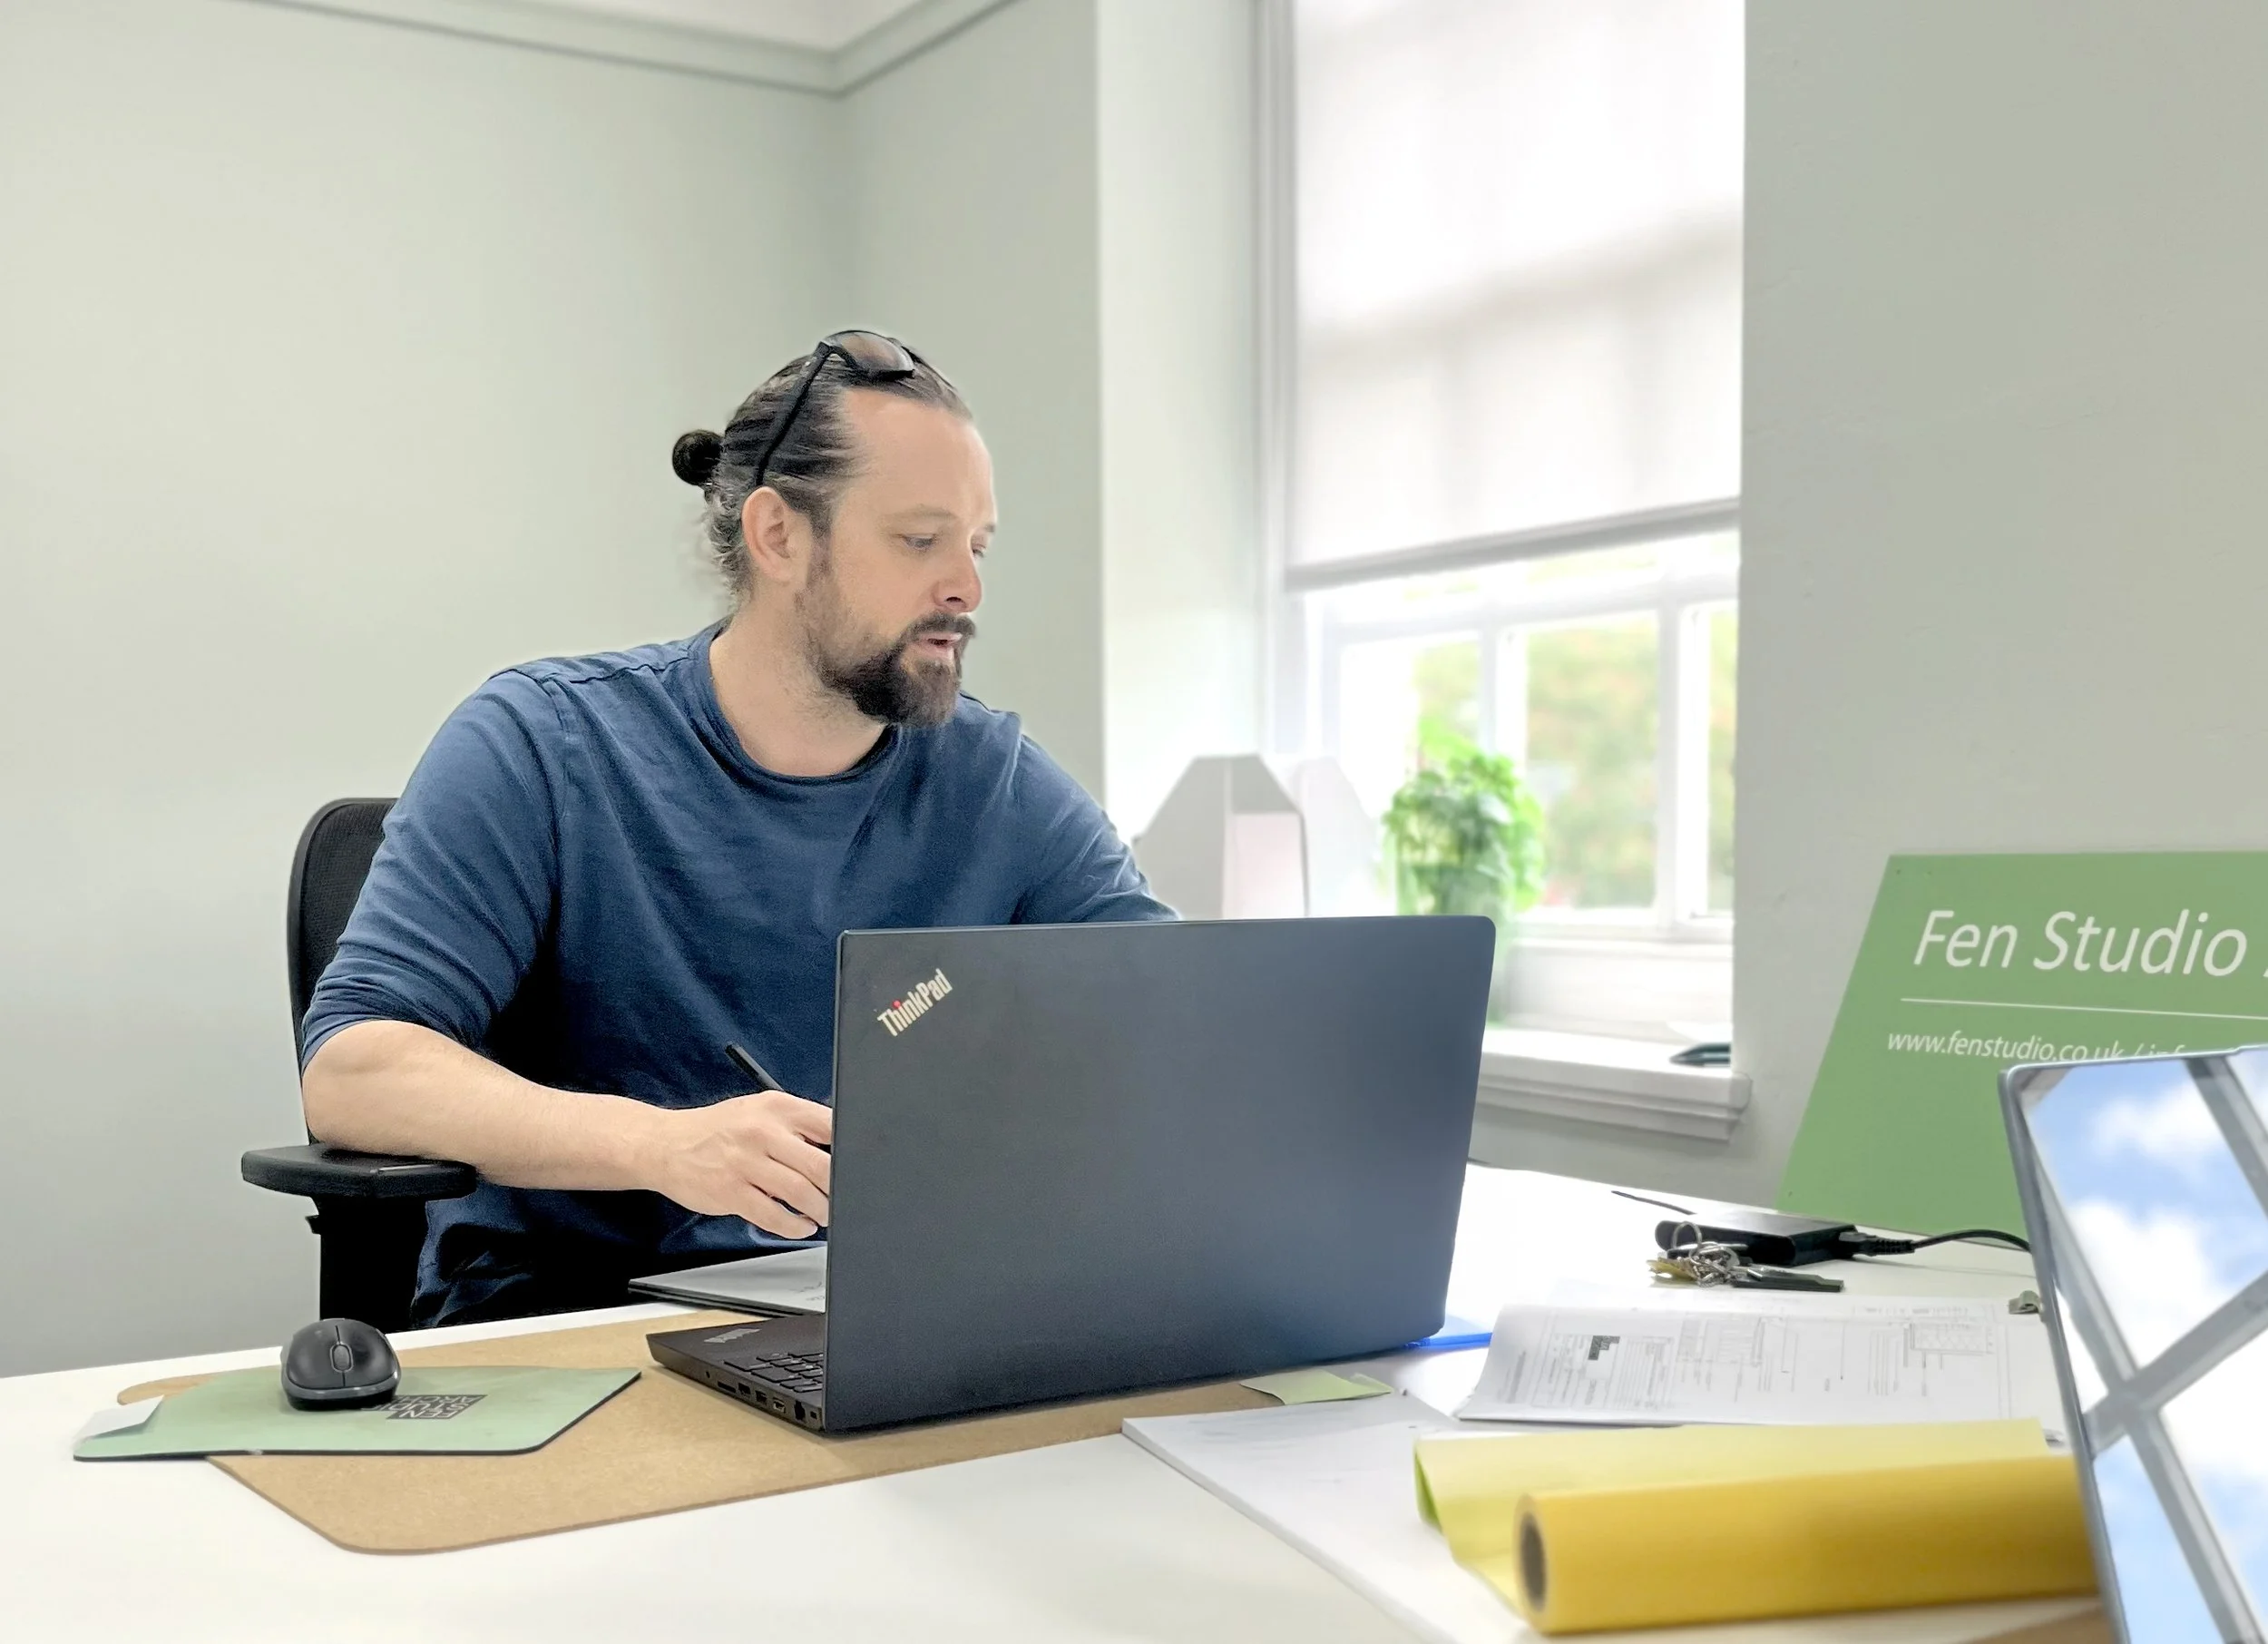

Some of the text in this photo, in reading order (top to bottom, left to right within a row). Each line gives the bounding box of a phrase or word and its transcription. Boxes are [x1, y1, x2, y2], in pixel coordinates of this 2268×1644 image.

[1913, 909, 2019, 969] Fen
[2033, 908, 2248, 977] Studio
[876, 967, 953, 1037] ThinkPad
[1887, 1030, 2125, 1062] www.fenstudio.couk
[398, 1410, 458, 1418] FEN
